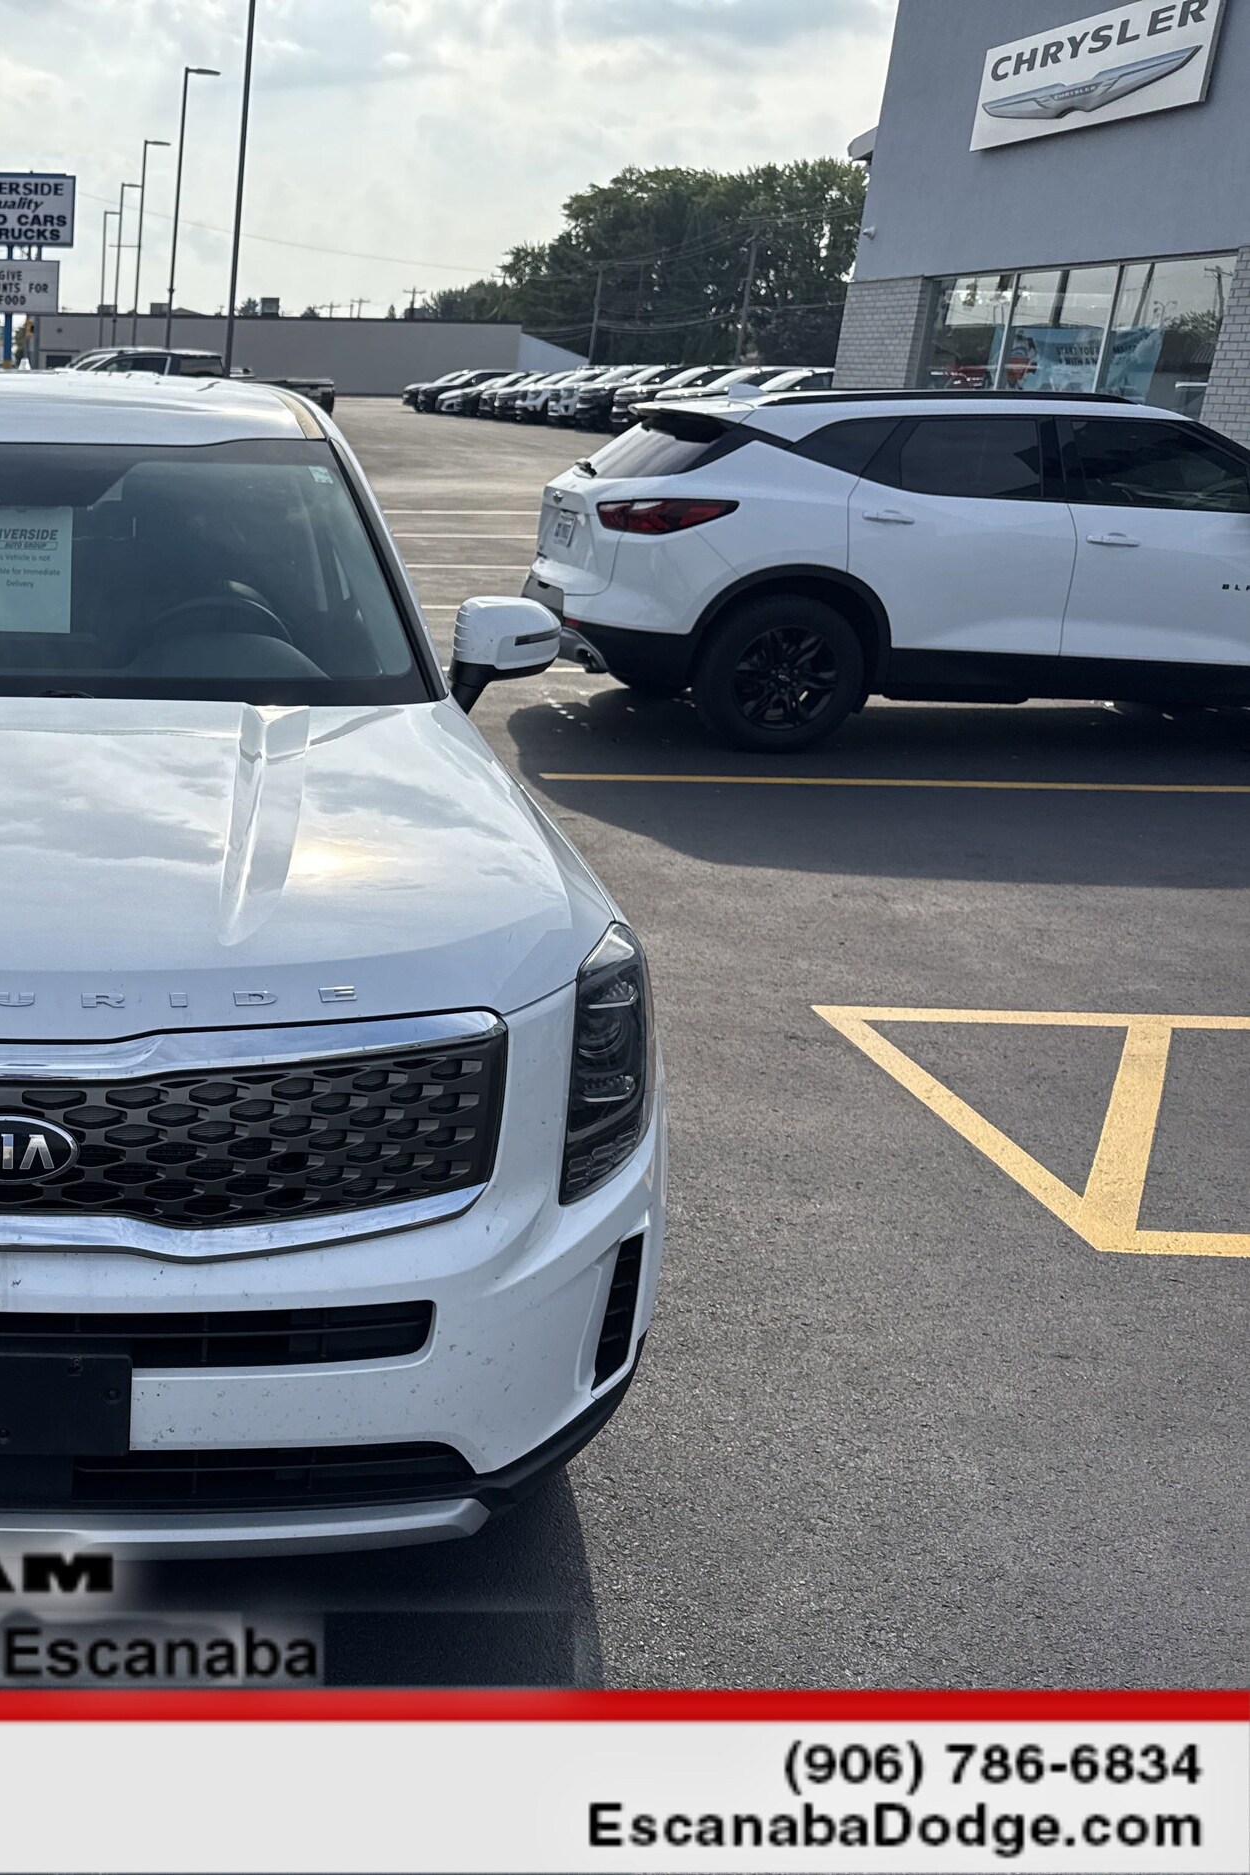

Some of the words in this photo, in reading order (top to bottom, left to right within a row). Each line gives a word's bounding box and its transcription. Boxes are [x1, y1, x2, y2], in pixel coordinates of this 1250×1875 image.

[991, 0, 1207, 81] CHRYSLER
[17, 214, 67, 227] CARS
[28, 283, 49, 294] FOR
[5, 553, 30, 561] Vehicle
[38, 554, 51, 562] not
[12, 567, 22, 575] for
[6, 579, 35, 588] Delivery
